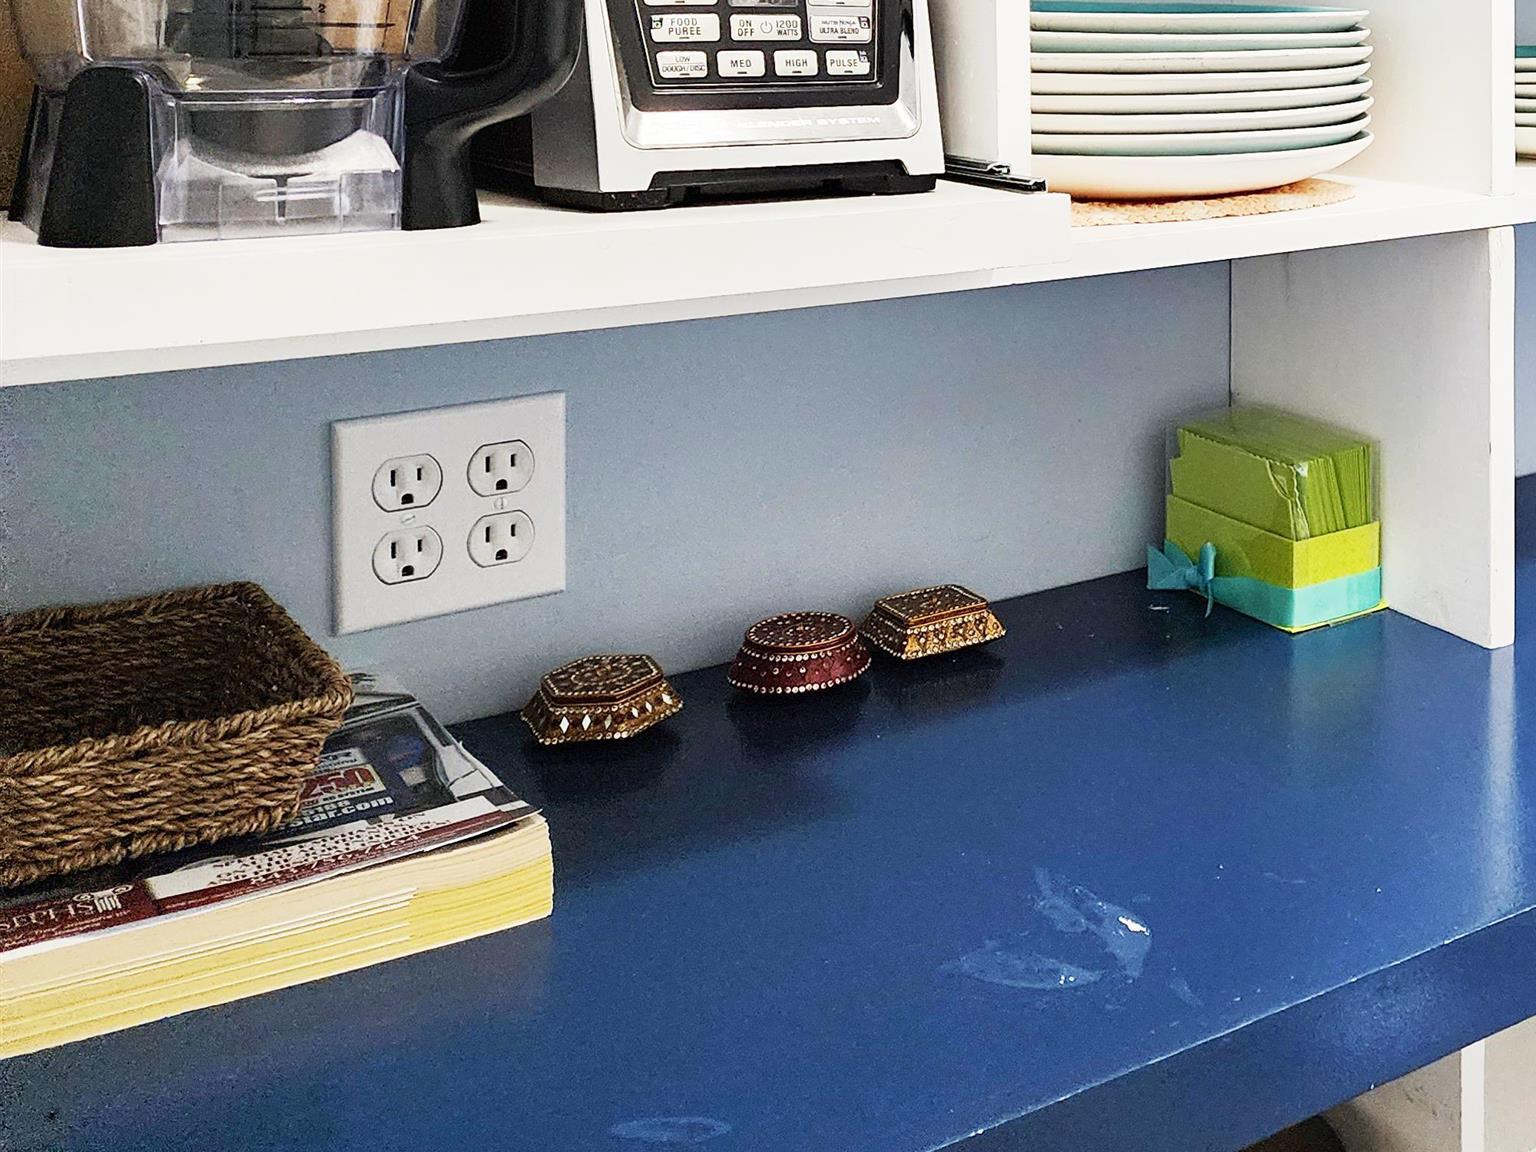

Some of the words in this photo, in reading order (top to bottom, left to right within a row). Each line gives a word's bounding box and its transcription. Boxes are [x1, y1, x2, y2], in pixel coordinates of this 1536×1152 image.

[318, 3, 326, 14] 2
[670, 17, 698, 27] FOOD
[738, 19, 752, 28] ON
[775, 19, 798, 29] 1200
[668, 27, 702, 36] PUREE
[737, 27, 755, 37] OFF
[777, 28, 799, 37] WATTS
[674, 55, 691, 63] LOW
[730, 59, 752, 68] MED
[785, 58, 808, 68] HIGH
[829, 58, 858, 68] PULSE
[815, 116, 881, 127] SYSTEM
